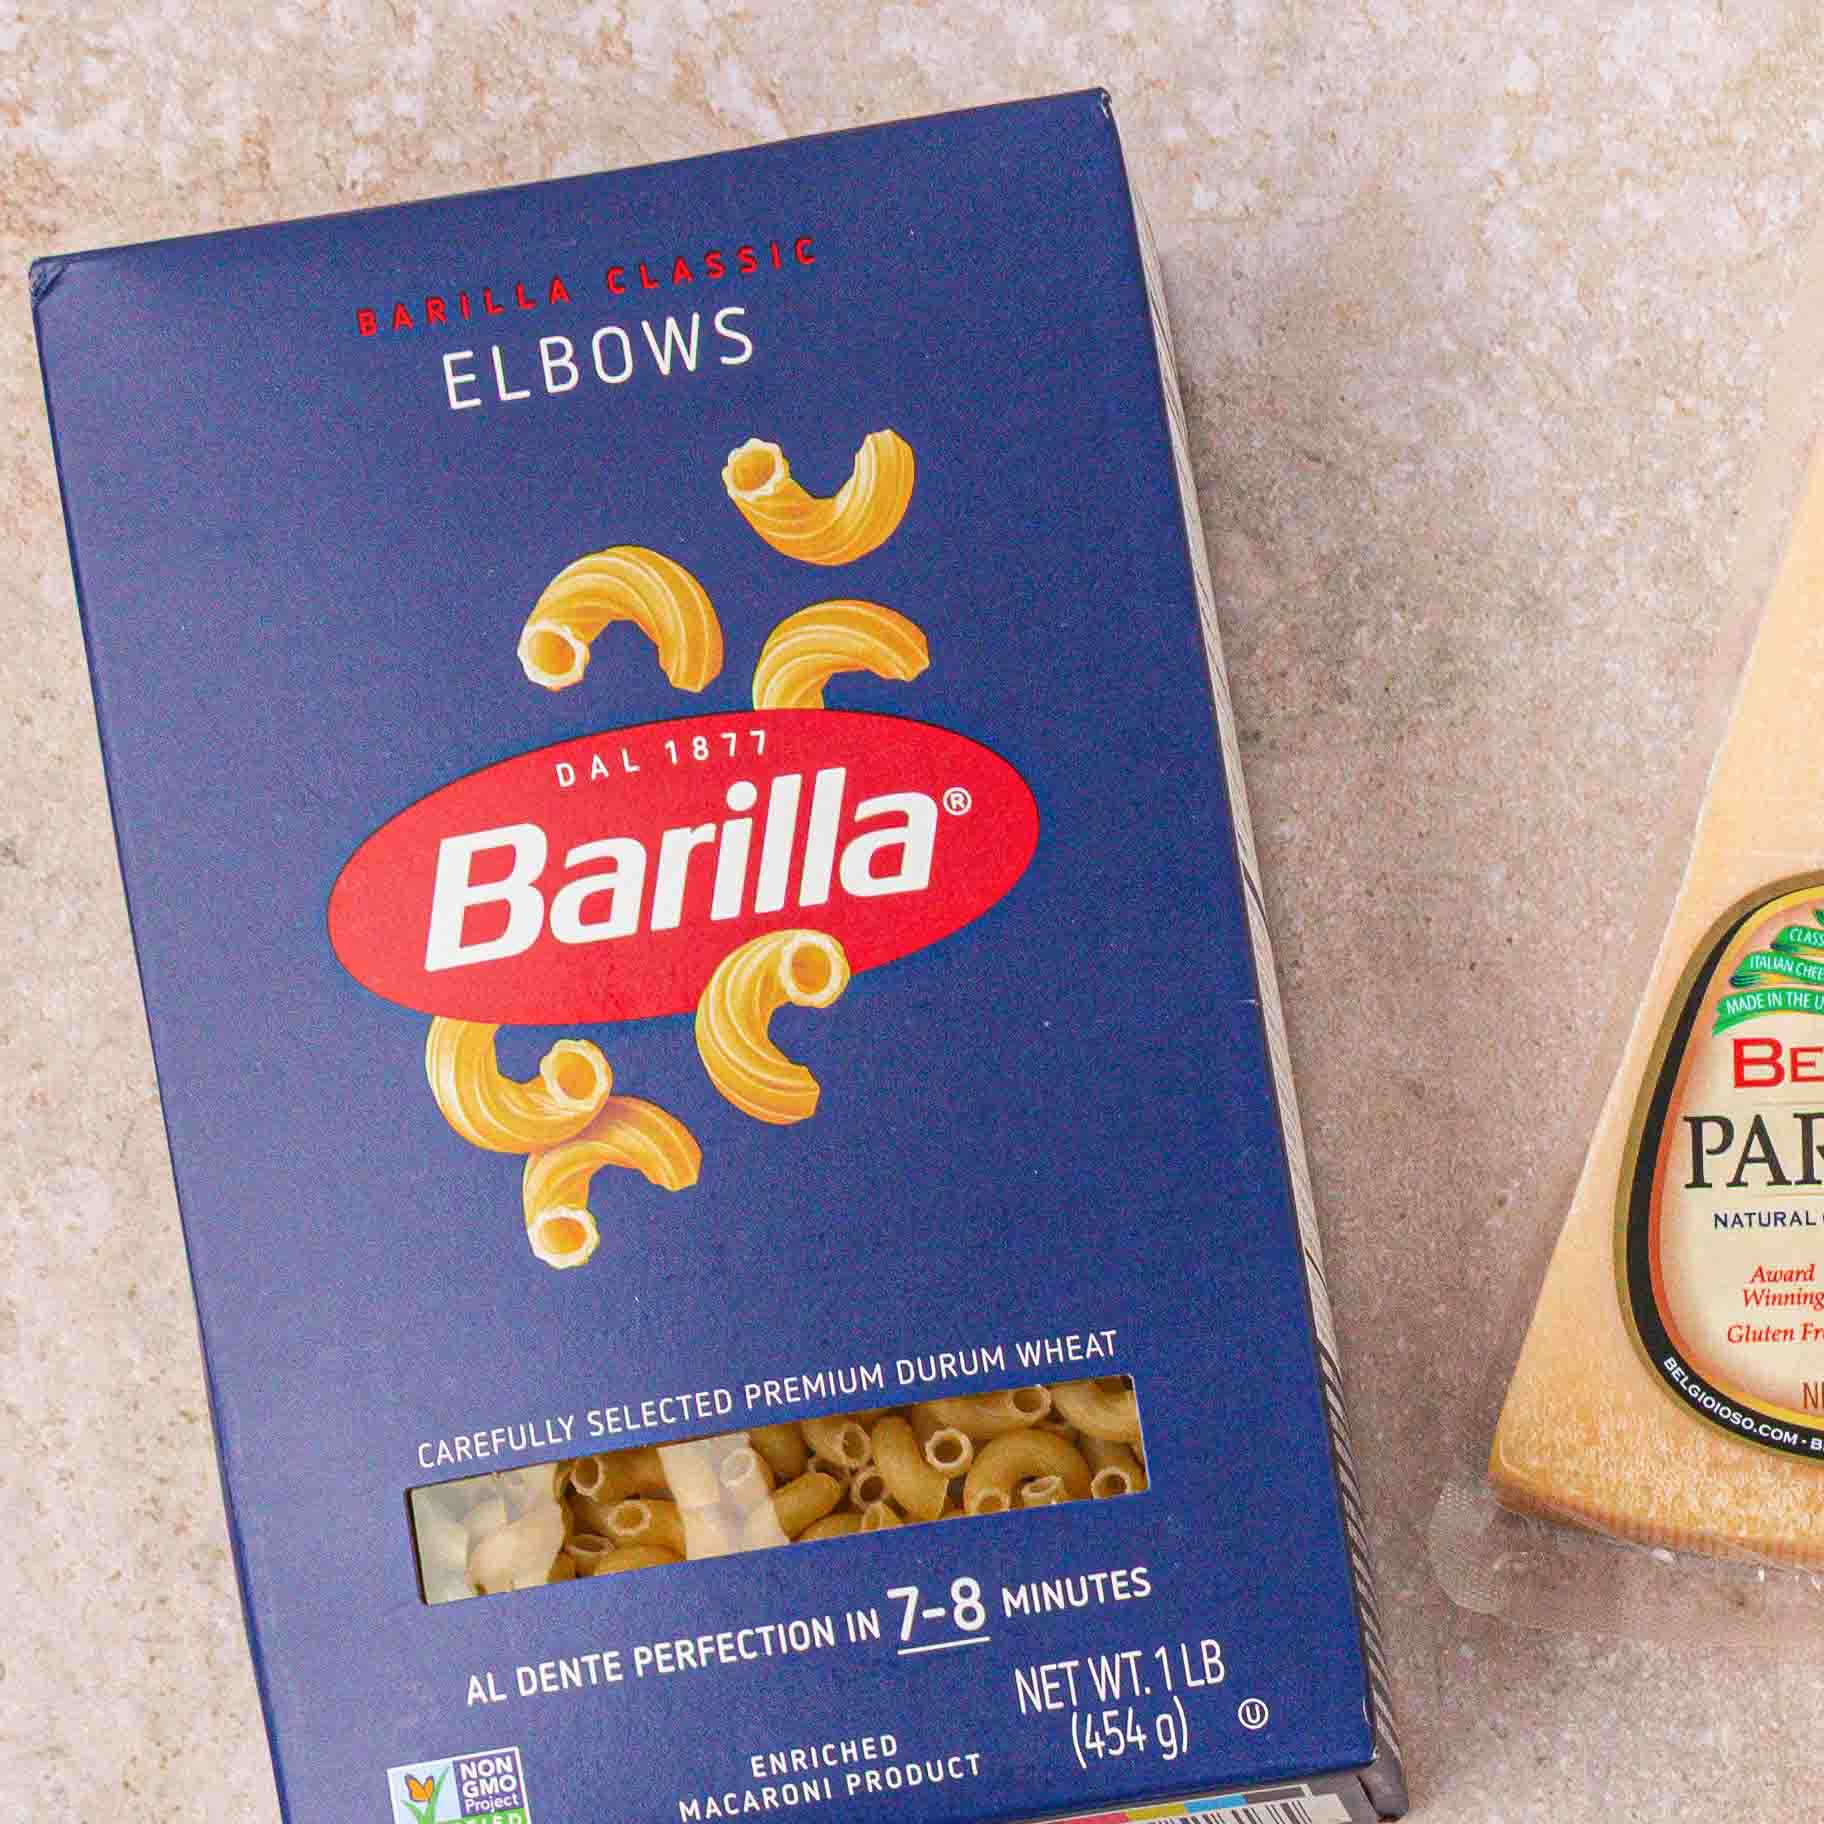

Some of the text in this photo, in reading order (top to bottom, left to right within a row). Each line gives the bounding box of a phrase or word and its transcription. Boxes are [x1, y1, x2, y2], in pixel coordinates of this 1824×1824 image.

[356, 237, 818, 337] BARILLA CLASSIC
[442, 305, 754, 410] ELBOWS
[556, 729, 769, 788] DAL 1877
[424, 766, 941, 973] Barilla
[1750, 955, 1794, 972] ITALIAN
[1726, 994, 1766, 1015] MADE
[1713, 1209, 1817, 1230] NATURAL
[1749, 1263, 1815, 1284] Award
[1742, 1286, 1824, 1313] Winning
[1727, 1325, 1795, 1345] Gluten
[418, 1330, 1117, 1469] CAREFULLY SELECTED PREMIUM DURUM WHEAT
[467, 1567, 1151, 1706] AL DENTE PERFECTION IN 7-8 MINUTES
[1015, 1639, 1225, 1715] NET WT. LB
[458, 1757, 513, 1779] NON
[751, 1733, 898, 1779] ENRICHED
[462, 1774, 518, 1800] GMO
[464, 1791, 520, 1816] Project
[679, 1753, 981, 1823] MACARONI PRODUCT
